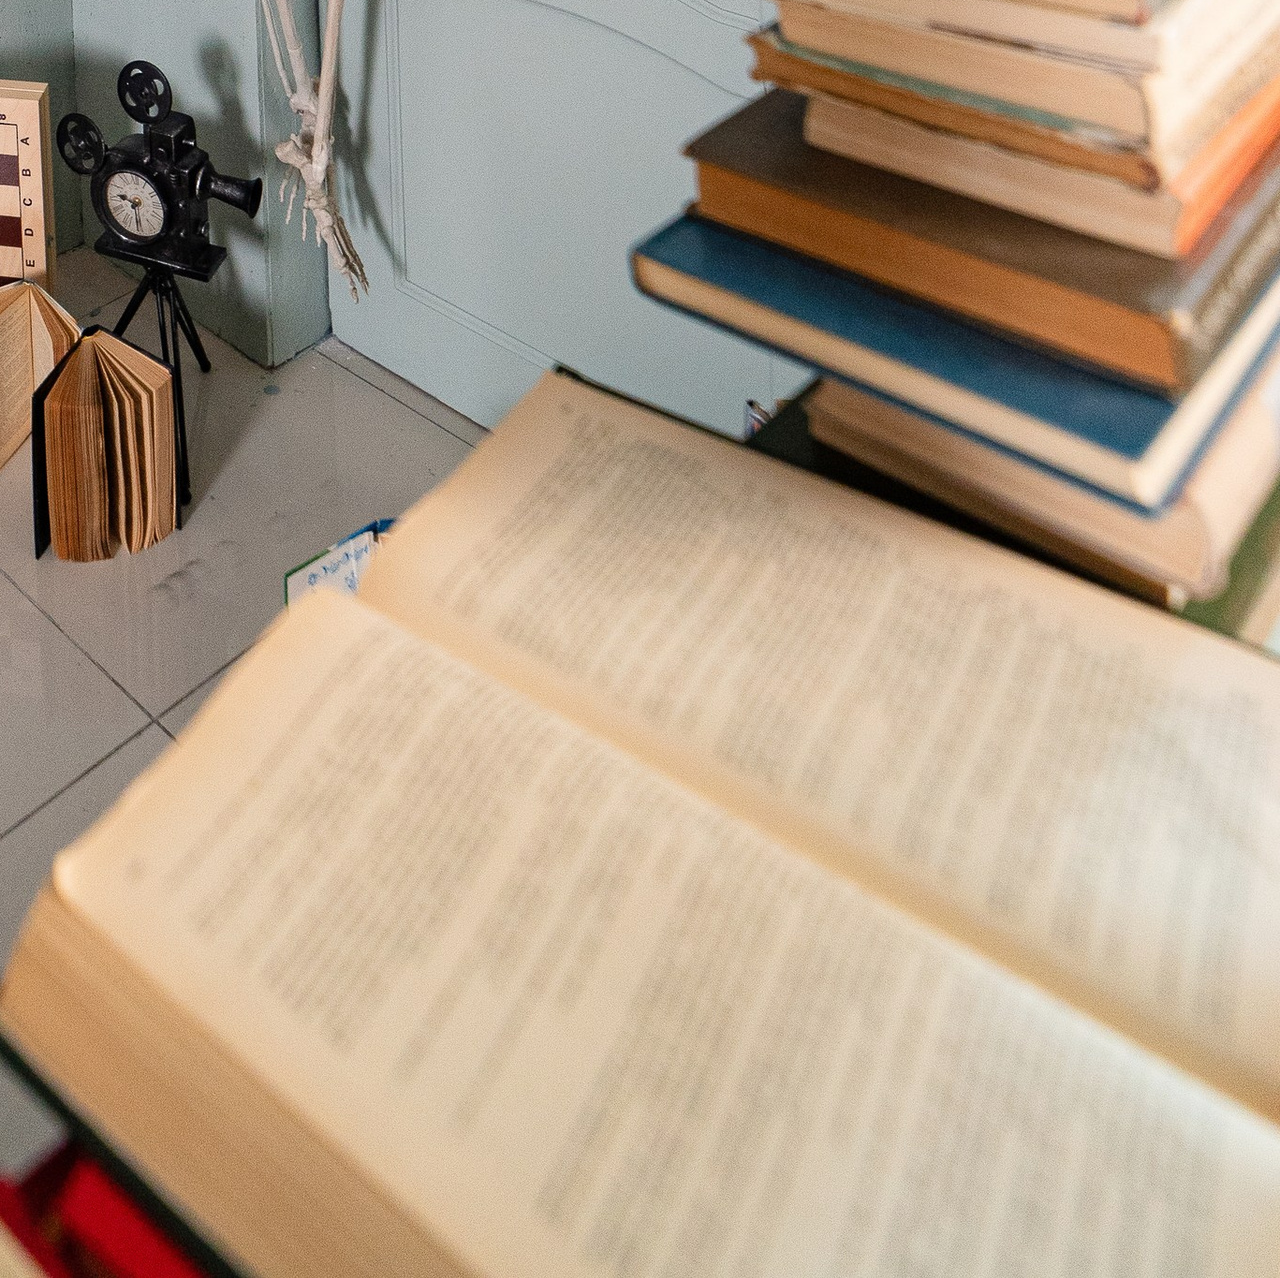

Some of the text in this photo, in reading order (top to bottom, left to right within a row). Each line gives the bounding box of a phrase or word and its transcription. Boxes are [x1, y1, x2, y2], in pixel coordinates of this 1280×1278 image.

[20, 136, 30, 146] A
[22, 168, 32, 177] B
[23, 197, 33, 206] C
[24, 228, 34, 236] D
[26, 259, 35, 268] E
